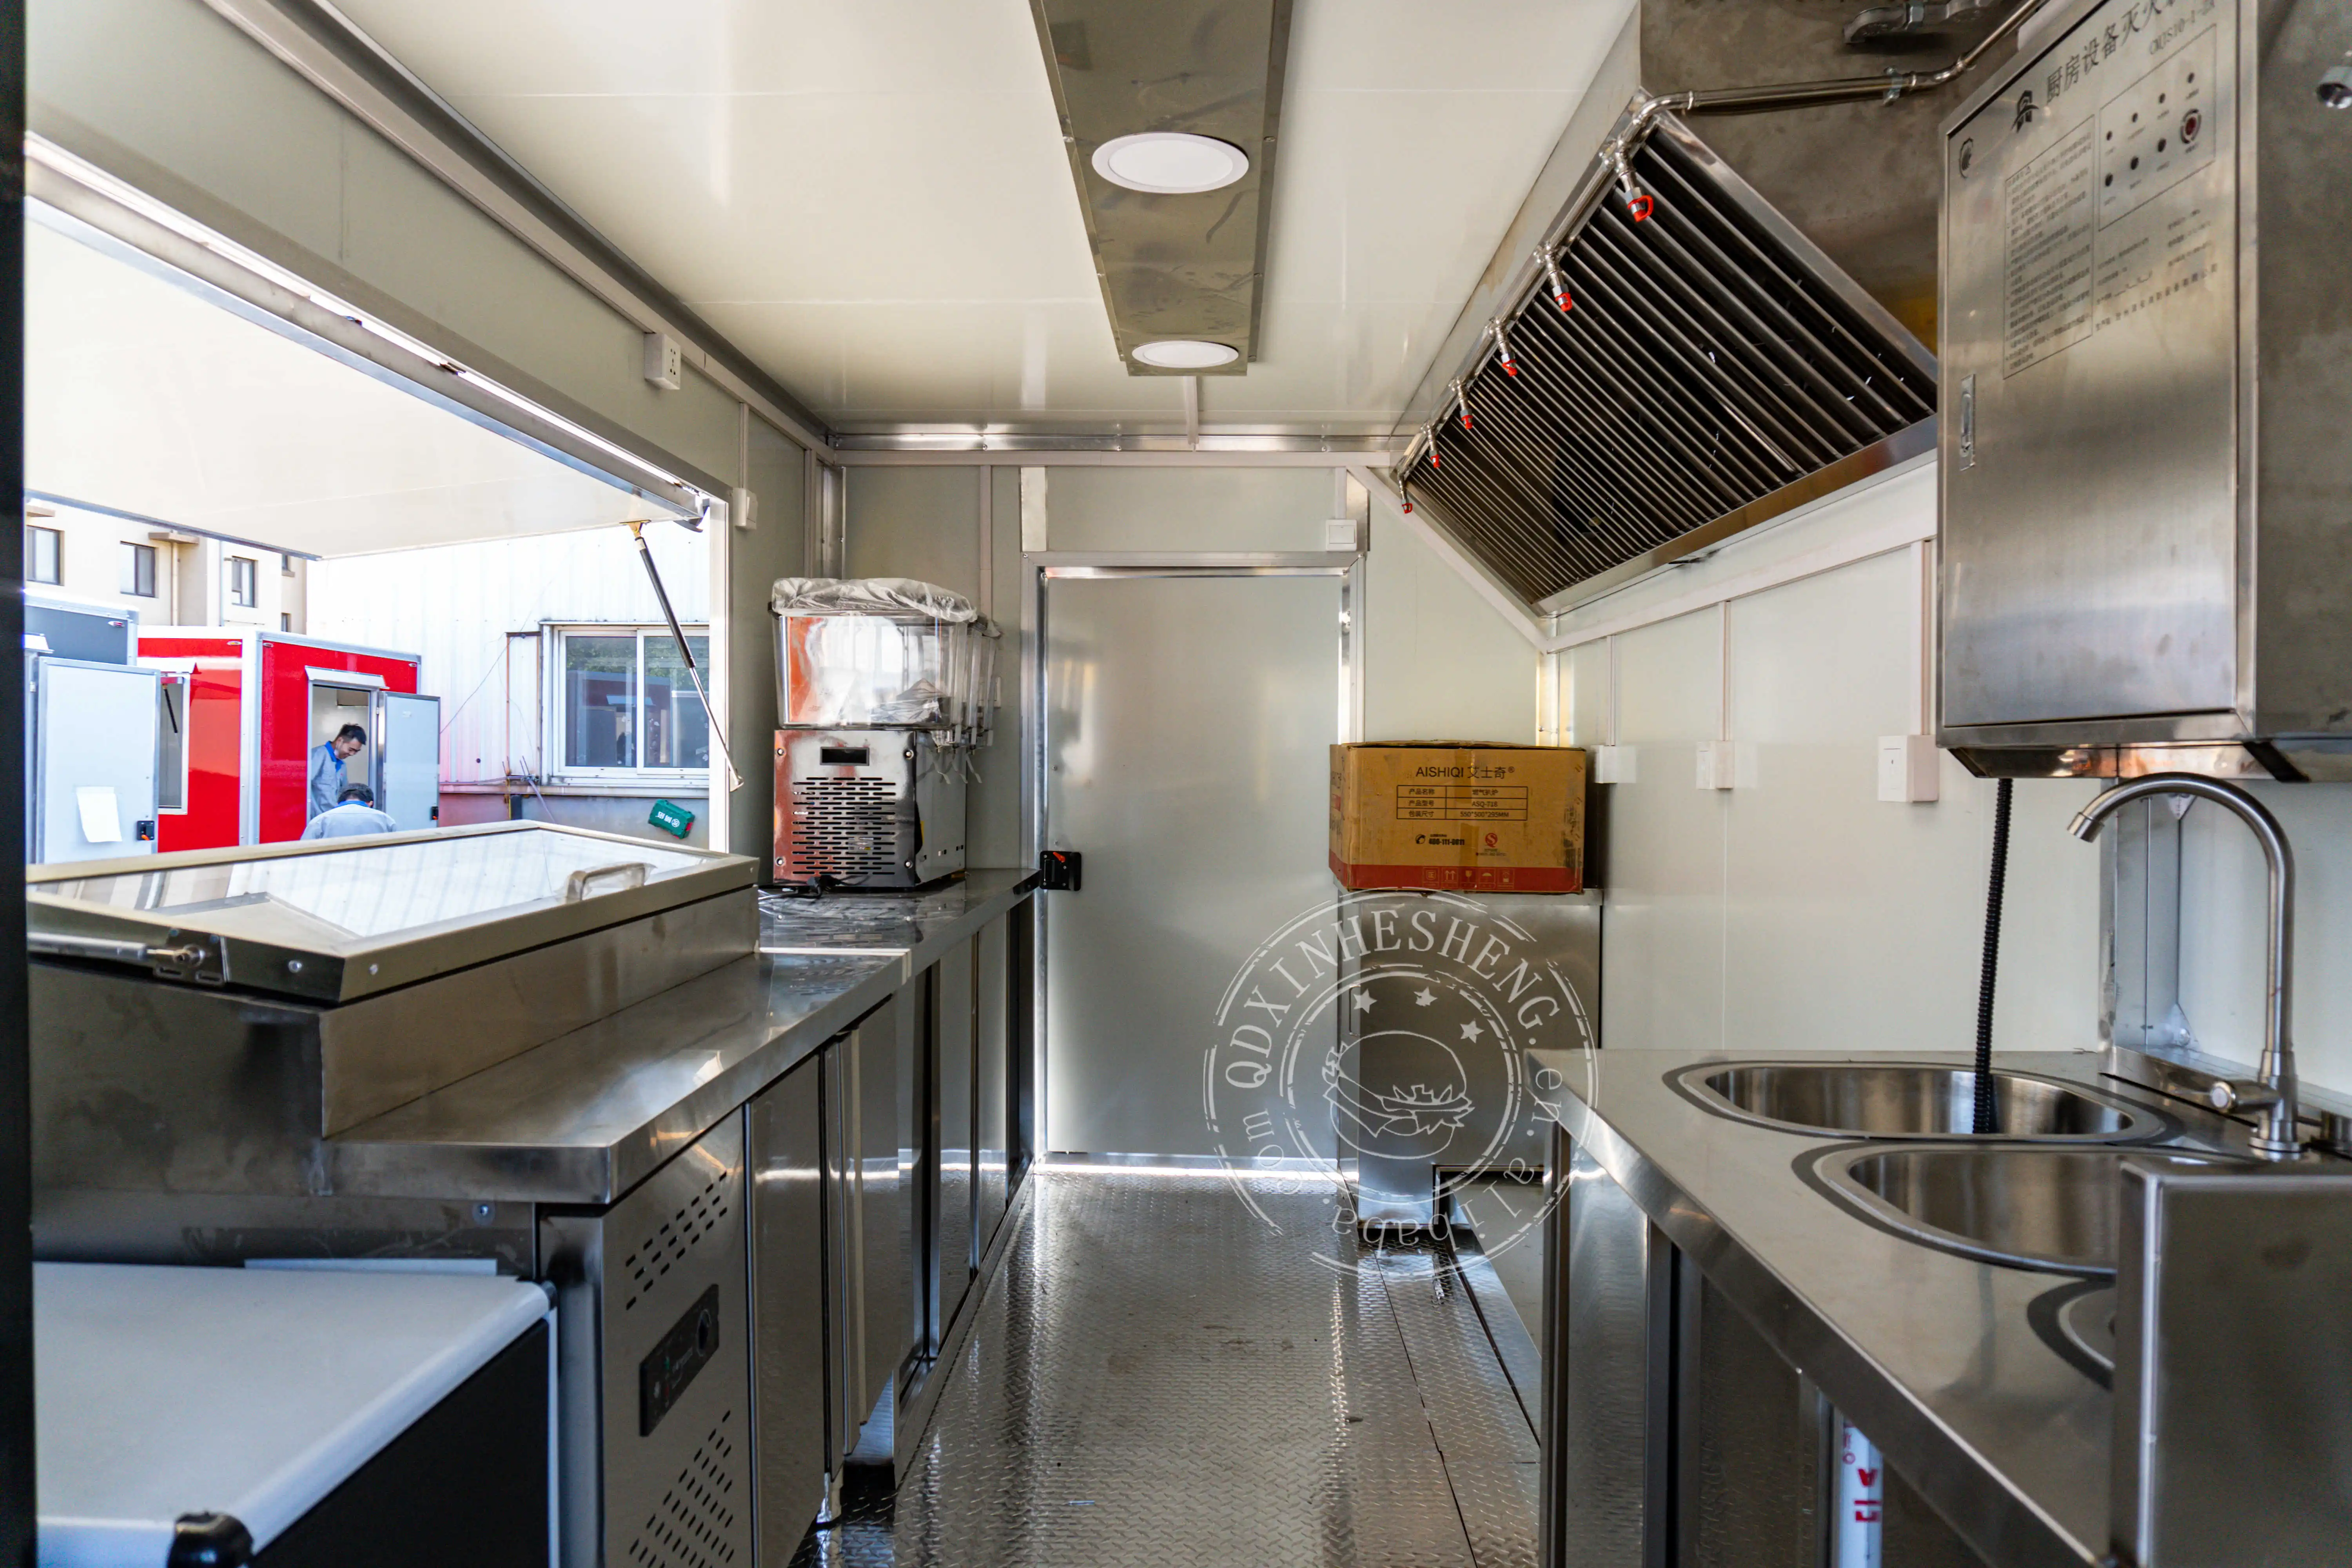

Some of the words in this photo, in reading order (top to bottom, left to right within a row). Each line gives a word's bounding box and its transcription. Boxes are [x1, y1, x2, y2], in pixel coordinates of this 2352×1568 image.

[2047, 0, 2175, 103] 厨房设备灭火
[1416, 767, 1463, 778] AISHIQI
